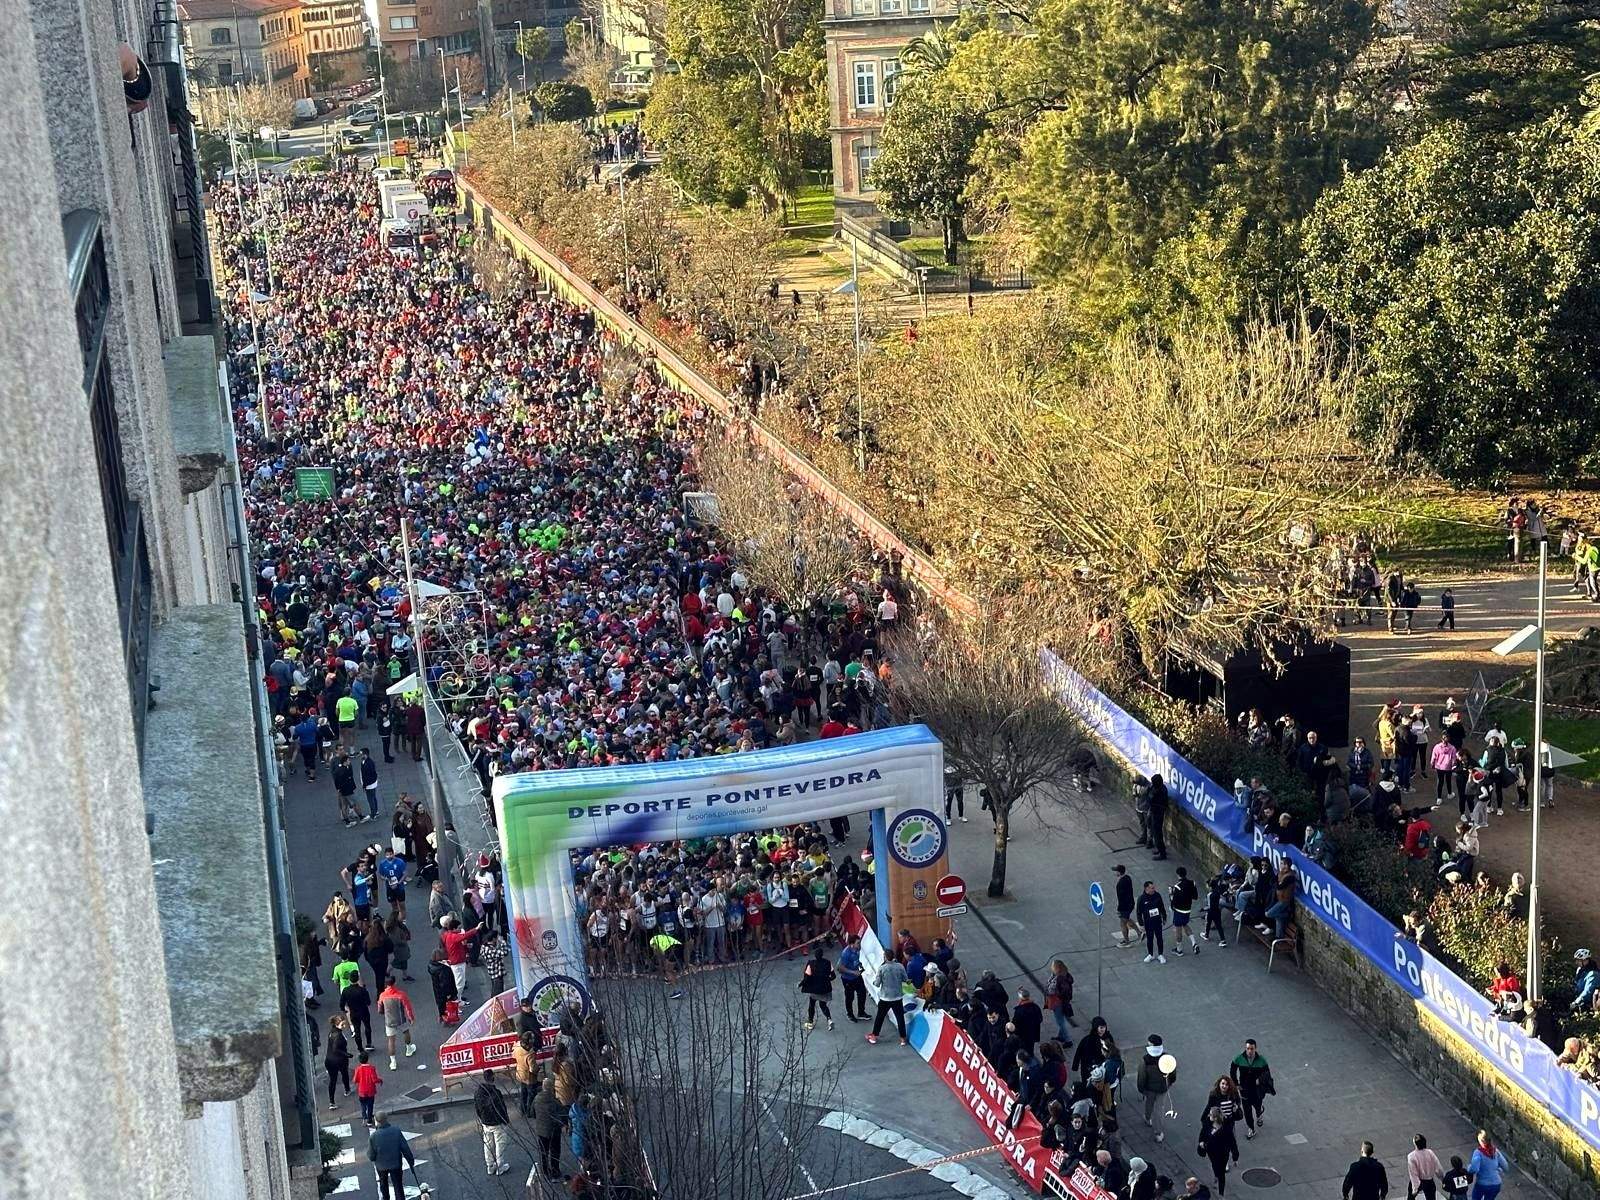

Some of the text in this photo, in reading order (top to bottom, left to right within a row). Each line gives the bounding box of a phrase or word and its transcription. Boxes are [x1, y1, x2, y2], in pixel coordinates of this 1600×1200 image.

[568, 768, 882, 819] DEPORTE PONTEVEDRA
[1140, 736, 1217, 822] Pontevedra
[897, 817, 936, 831] DEPORTE
[895, 838, 940, 862] PONTEVEDRA
[1394, 941, 1524, 1073] Pontevedra
[441, 1050, 473, 1065] FROIZ
[483, 1042, 514, 1058] FROIZ
[953, 1032, 1015, 1117] DEPORTE
[944, 1057, 1036, 1179] PONTEVEDRA
[1073, 1169, 1093, 1193] FROIZ
